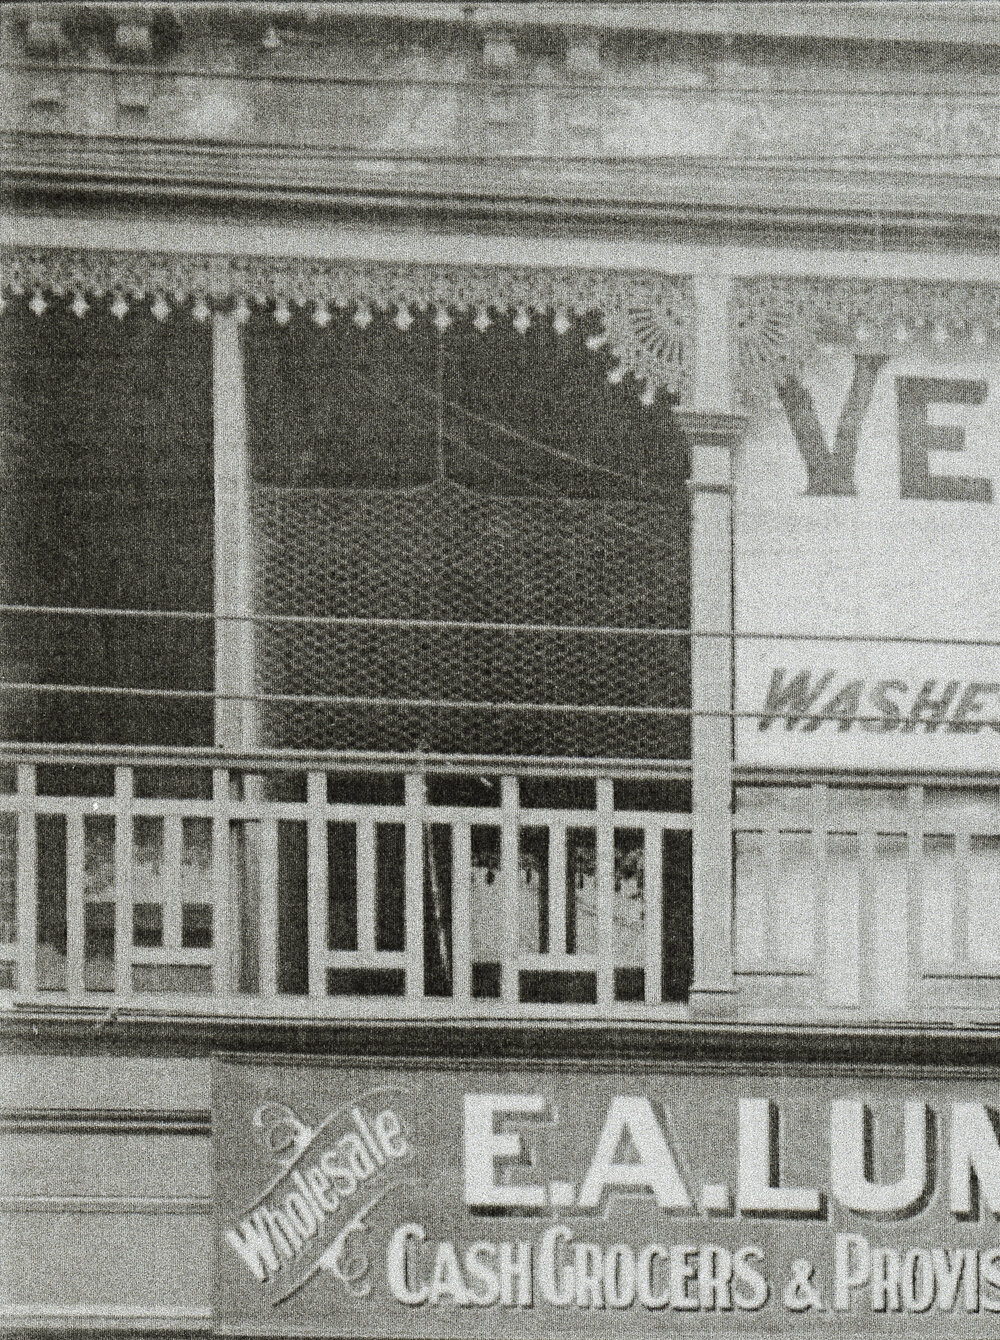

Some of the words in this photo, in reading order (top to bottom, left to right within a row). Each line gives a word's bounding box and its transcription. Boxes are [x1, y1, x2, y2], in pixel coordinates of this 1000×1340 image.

[224, 1101, 411, 1284] Wholesale
[386, 1222, 536, 1310] CASH
[539, 1224, 771, 1314] GROCERS
[782, 1260, 825, 1313] &
